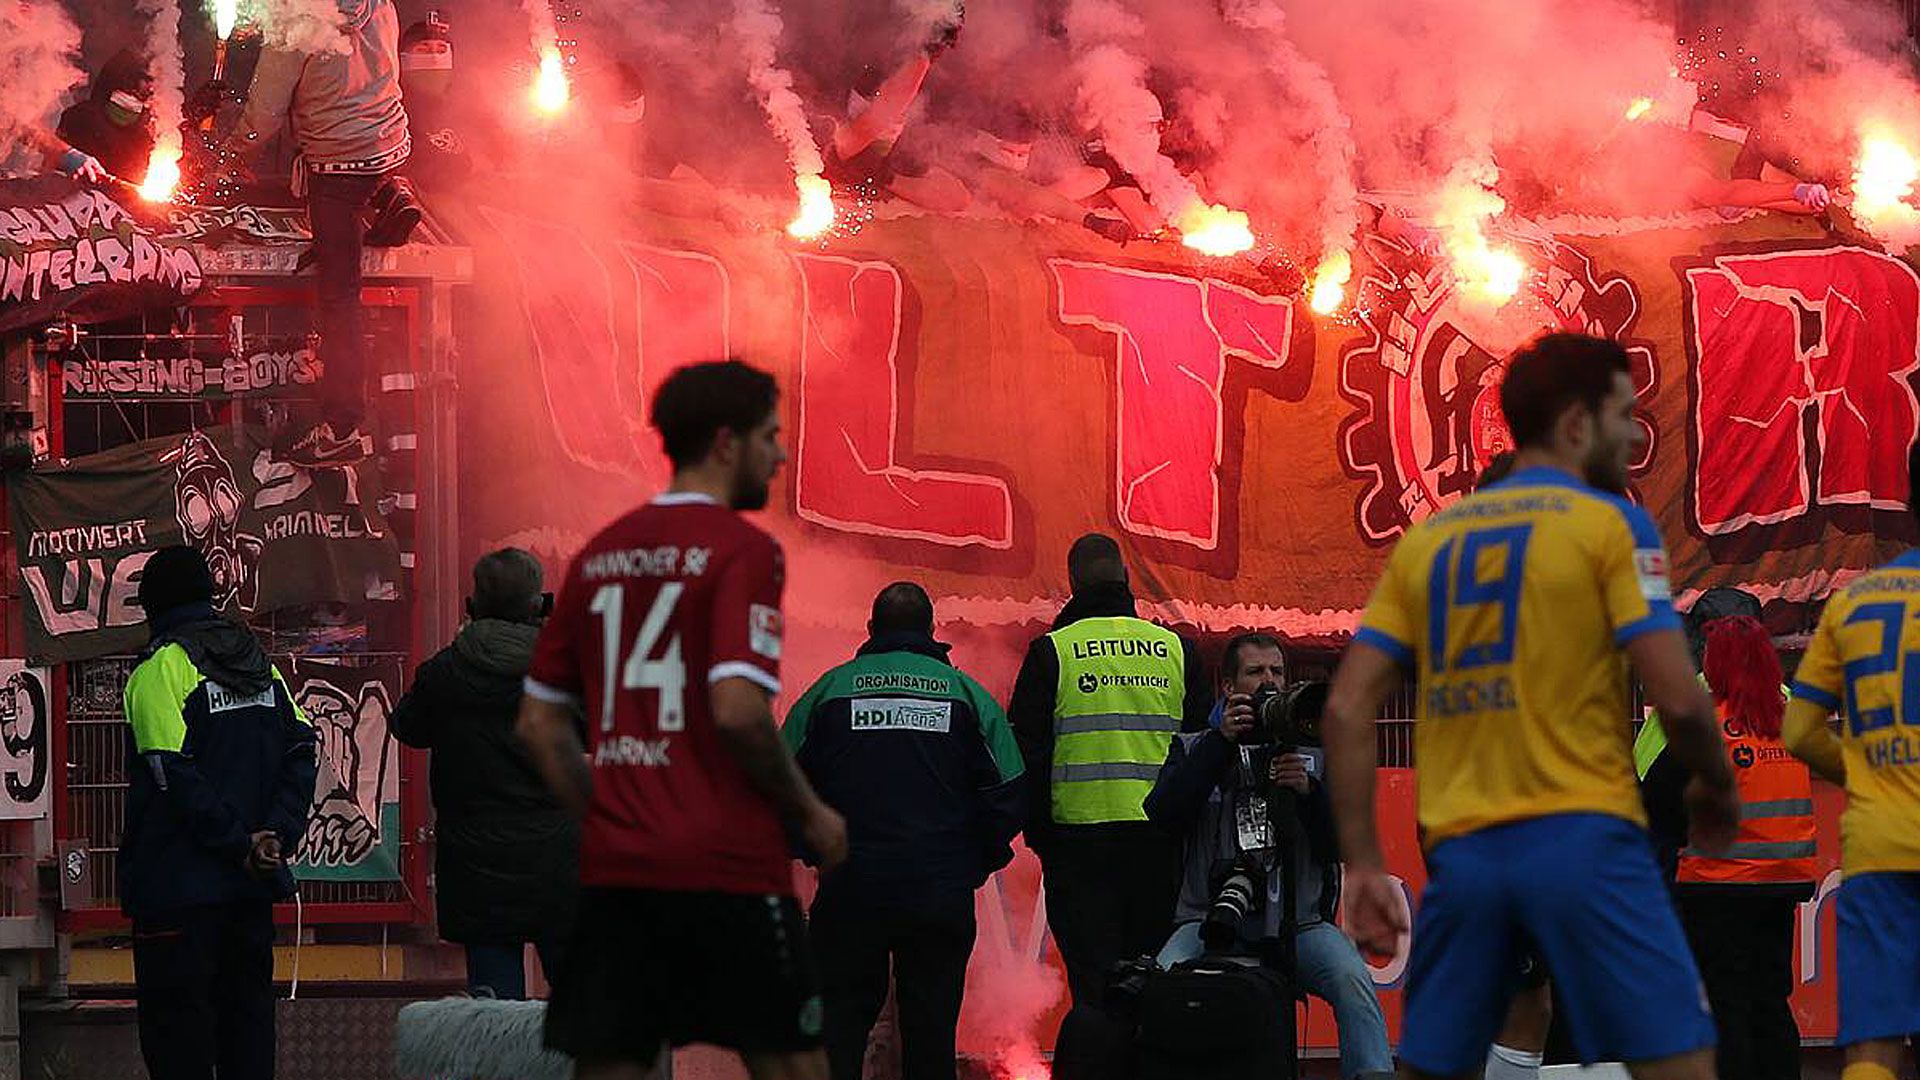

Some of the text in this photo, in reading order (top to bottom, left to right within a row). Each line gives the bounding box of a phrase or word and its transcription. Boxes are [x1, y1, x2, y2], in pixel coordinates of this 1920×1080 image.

[0, 233, 203, 302] NTERRANG
[28, 519, 146, 557] MOTIVIERT
[1429, 521, 1535, 675] 19
[590, 582, 686, 732] 14
[1073, 639, 1168, 659] LEITUNG
[855, 674, 949, 693] ORGANISATION
